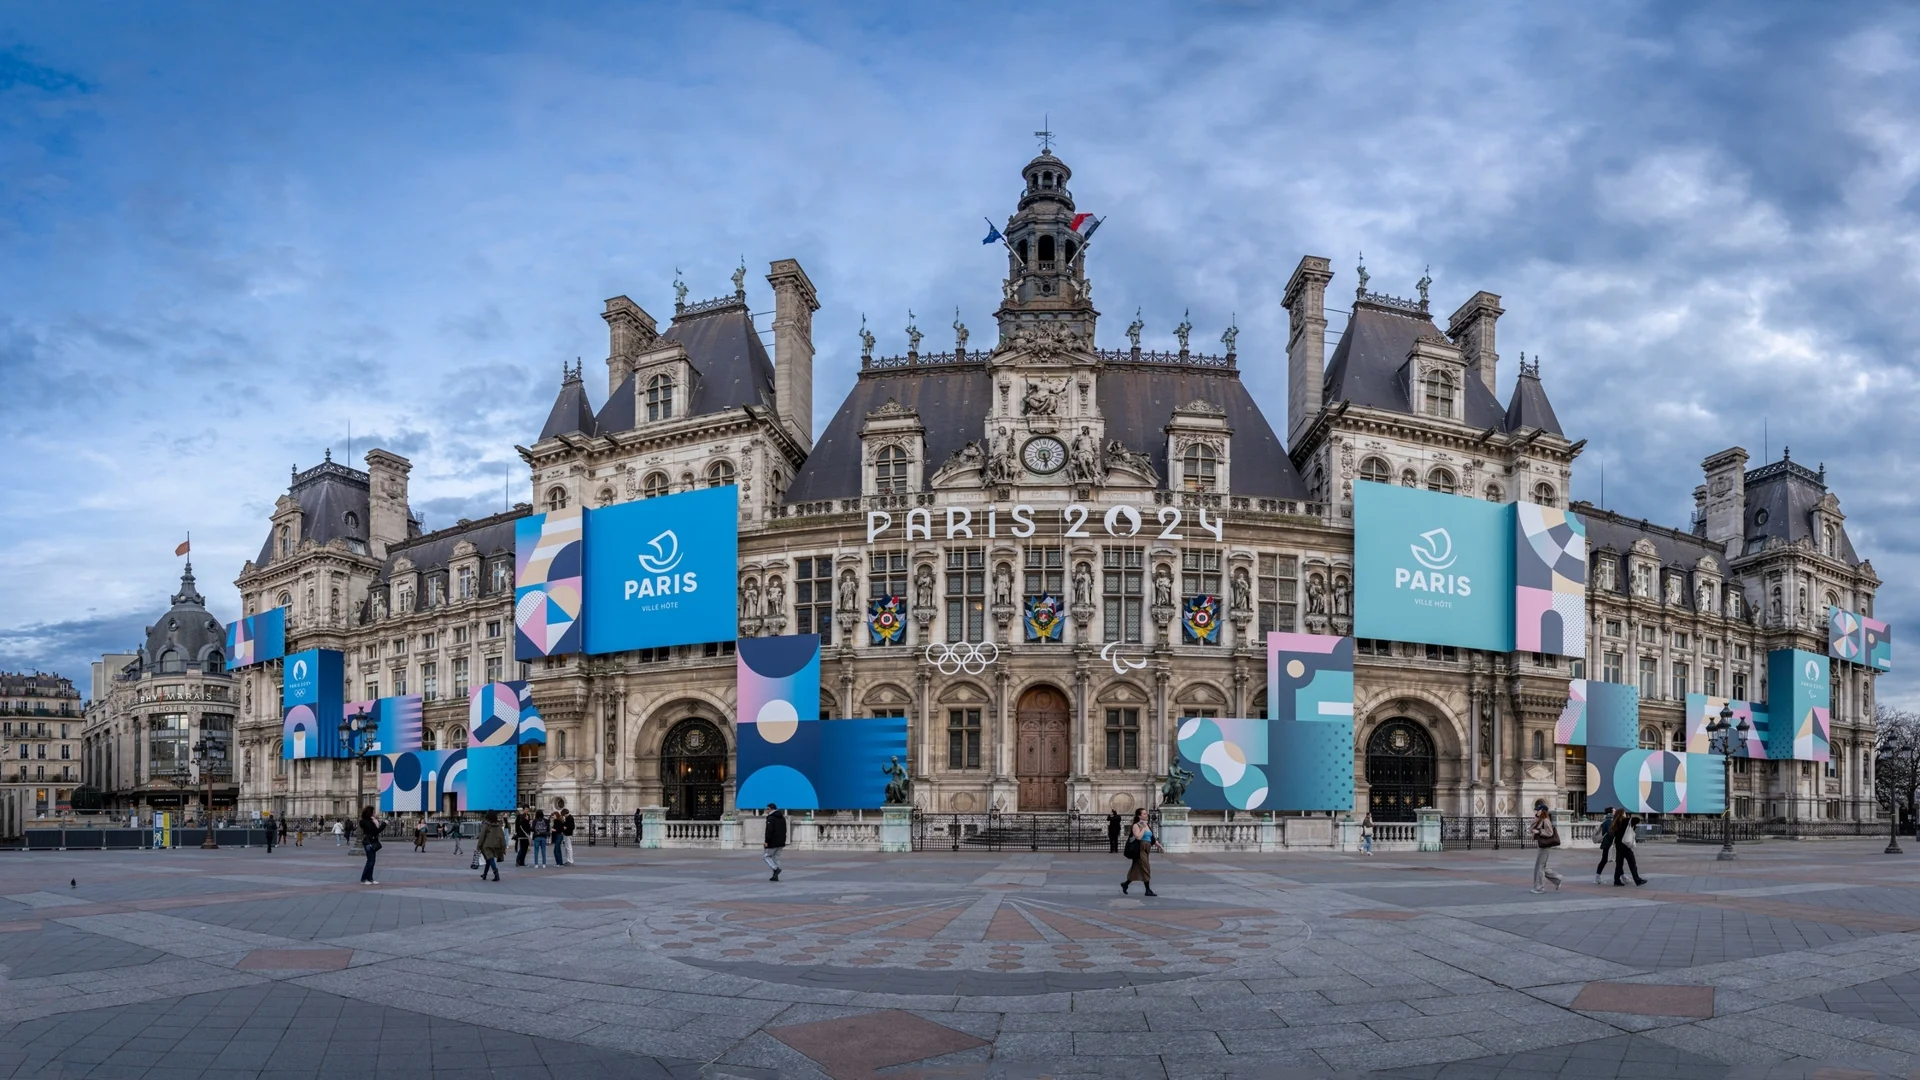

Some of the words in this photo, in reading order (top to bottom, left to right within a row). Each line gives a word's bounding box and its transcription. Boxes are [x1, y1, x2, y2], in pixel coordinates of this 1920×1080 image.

[867, 504, 1036, 544] PARIS
[1063, 504, 1223, 542] 2024
[624, 571, 698, 601] PARIS
[1395, 567, 1472, 597] PARIS
[641, 603, 660, 612] VILLE
[660, 601, 679, 610] HÔTE
[1414, 598, 1433, 607] VILLE
[1434, 600, 1453, 609] HÔTE
[140, 694, 158, 703] BHV
[167, 692, 212, 701] MARAIS
[202, 705, 226, 713] VILLE
